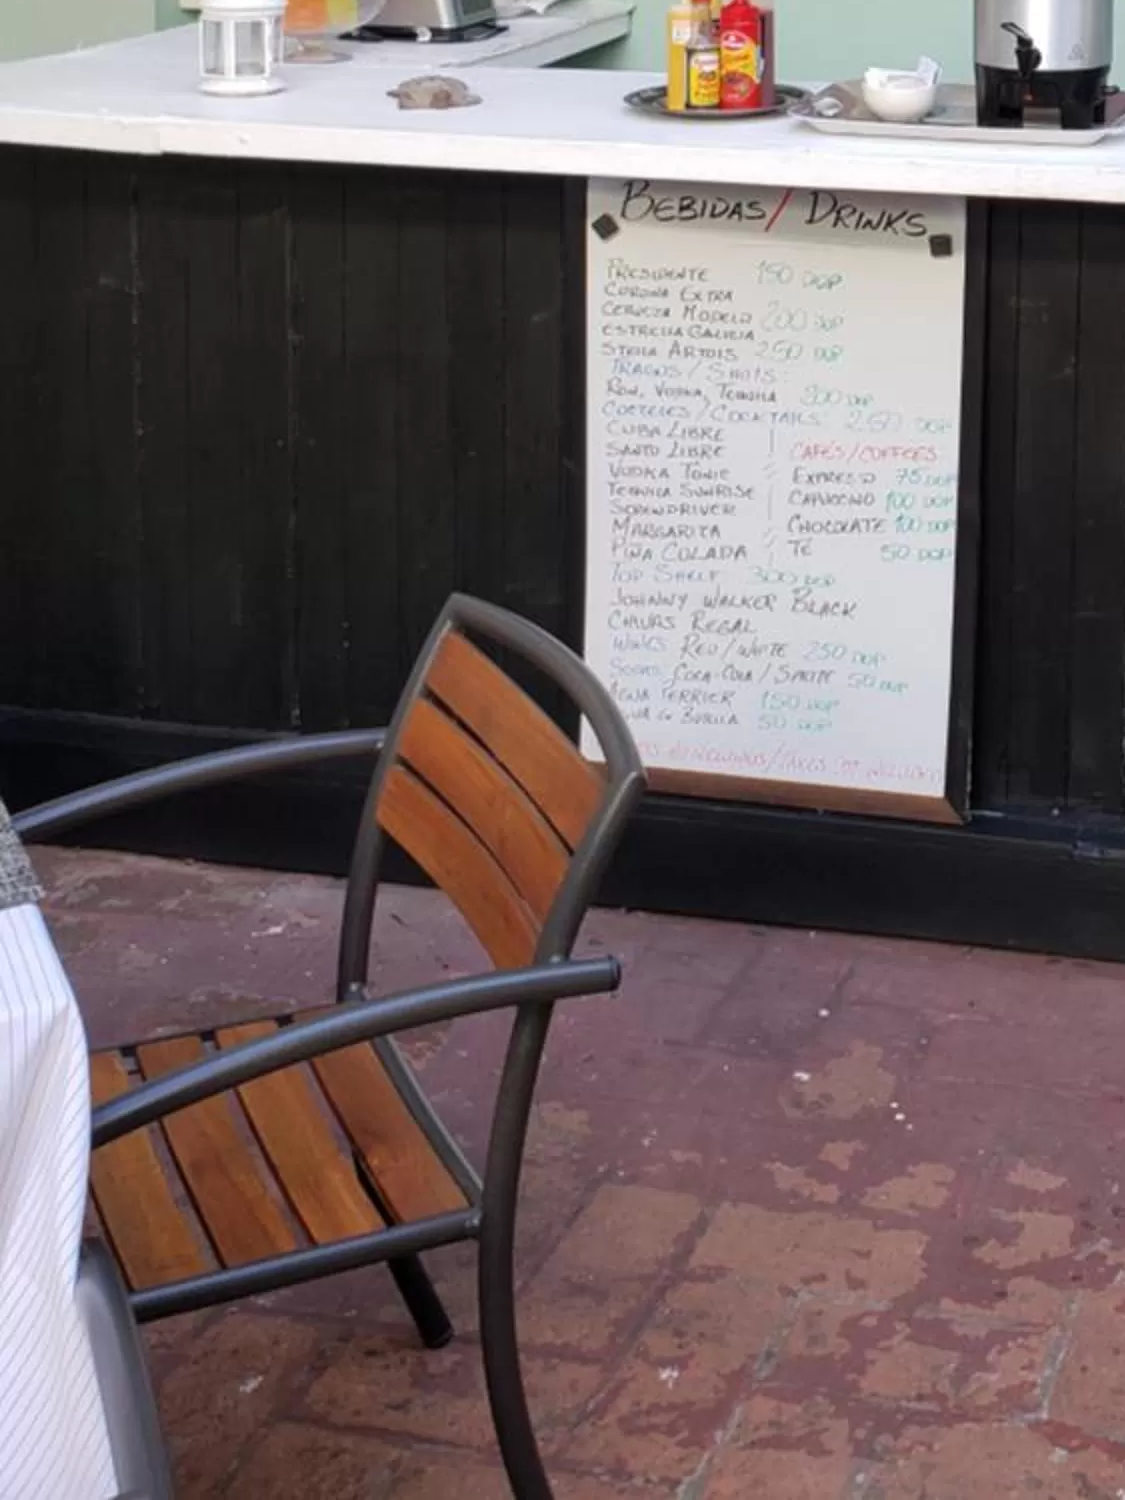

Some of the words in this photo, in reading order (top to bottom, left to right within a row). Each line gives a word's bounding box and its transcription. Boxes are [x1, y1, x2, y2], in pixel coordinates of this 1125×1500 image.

[804, 190, 927, 239] DRINKS
[606, 419, 661, 440] CUBA
[665, 419, 726, 442] LIBRE
[665, 440, 726, 460] LIBRE
[608, 458, 671, 480] VODKA
[659, 540, 750, 564] COLADA
